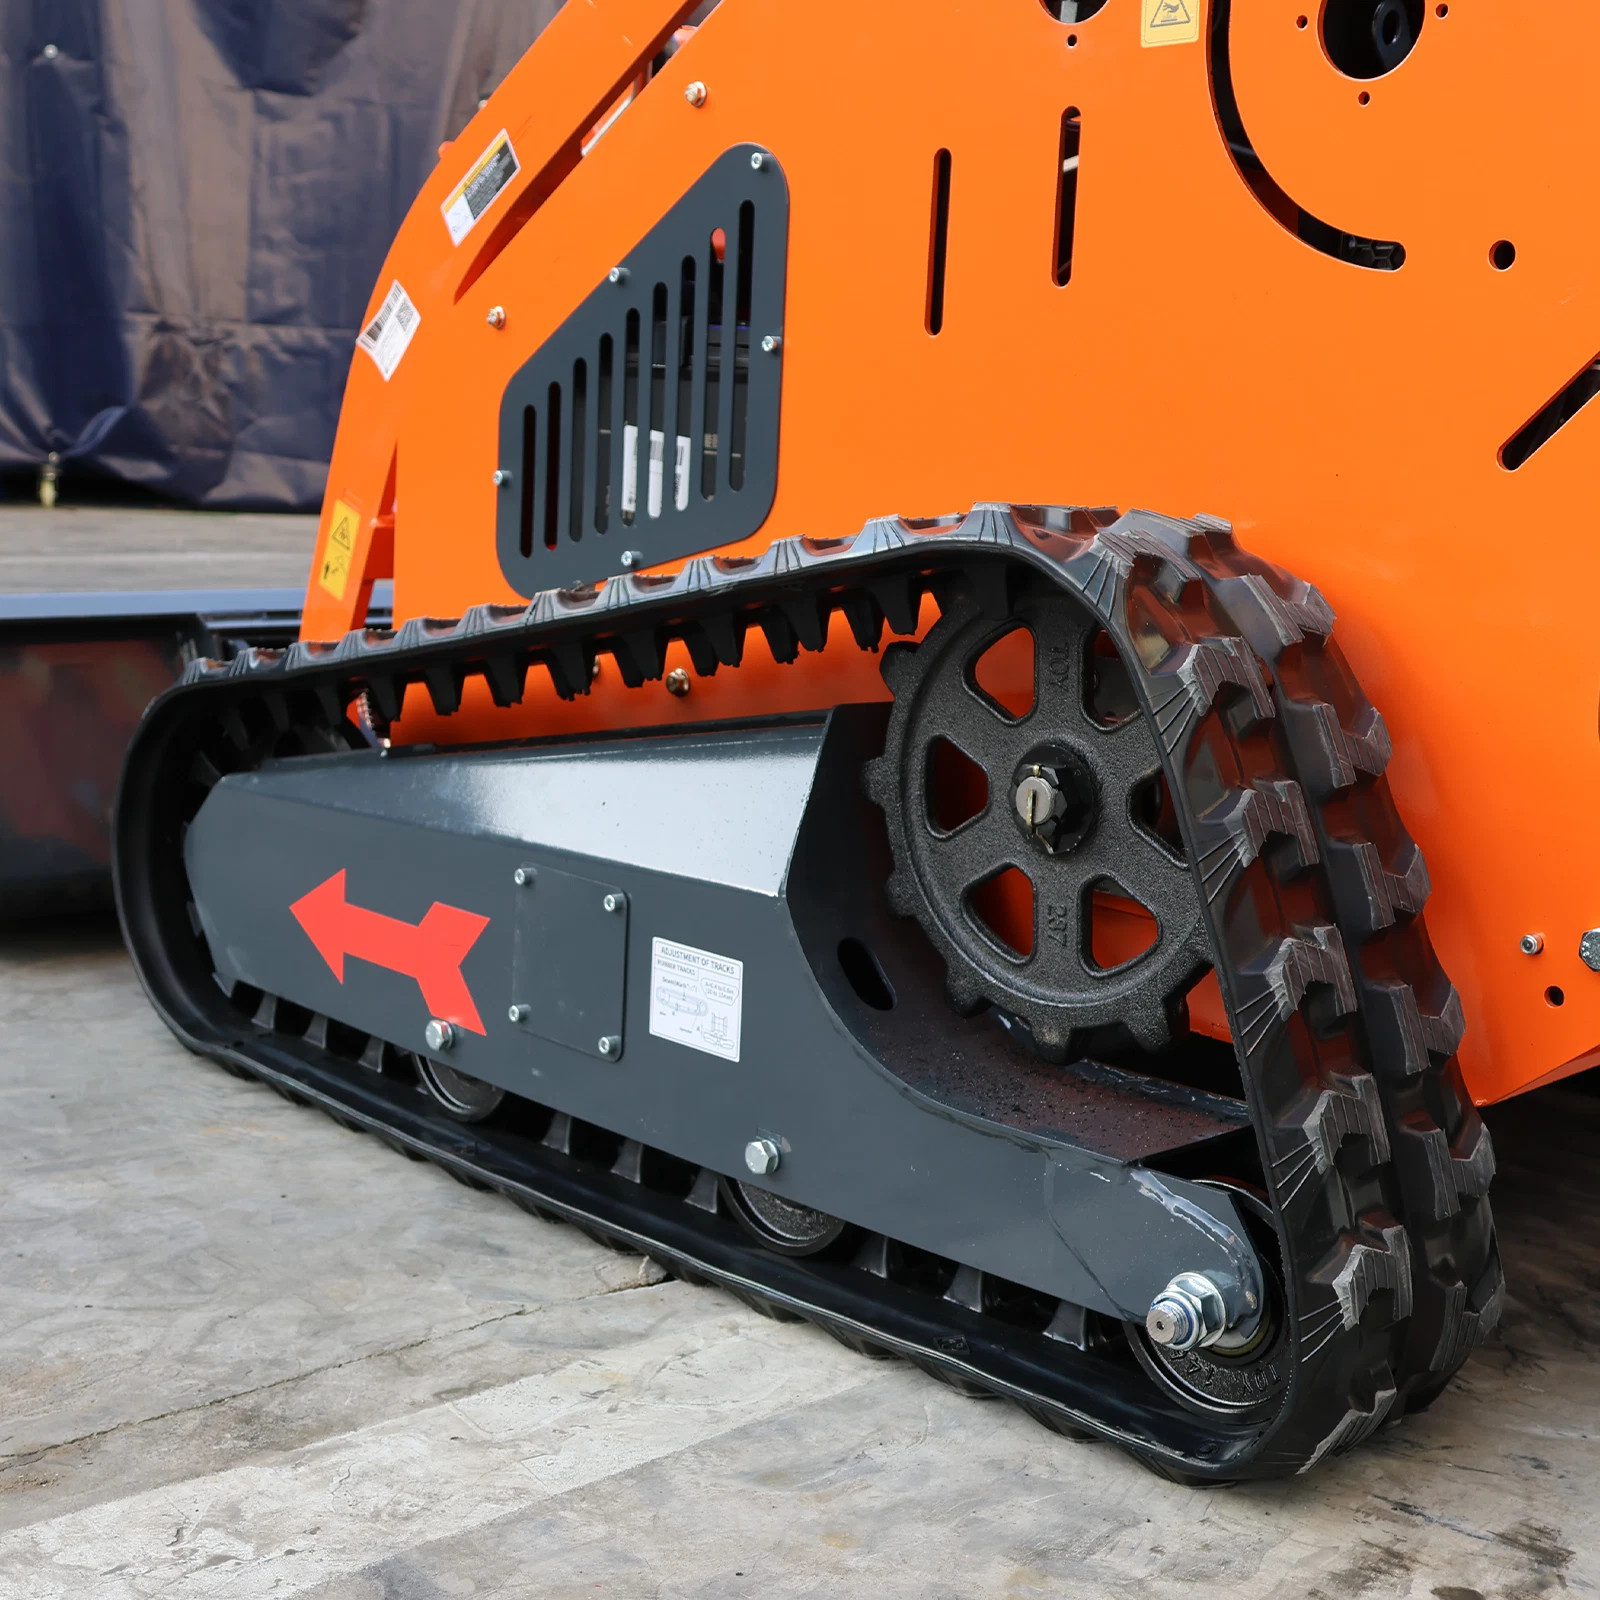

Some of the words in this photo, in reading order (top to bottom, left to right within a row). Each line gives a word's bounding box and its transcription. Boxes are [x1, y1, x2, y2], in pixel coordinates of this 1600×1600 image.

[1048, 642, 1069, 692] TOY
[1047, 904, 1068, 947] 237
[661, 946, 700, 964] ADJUSTMENT
[701, 957, 709, 967] OF
[711, 960, 735, 974] TRACKS
